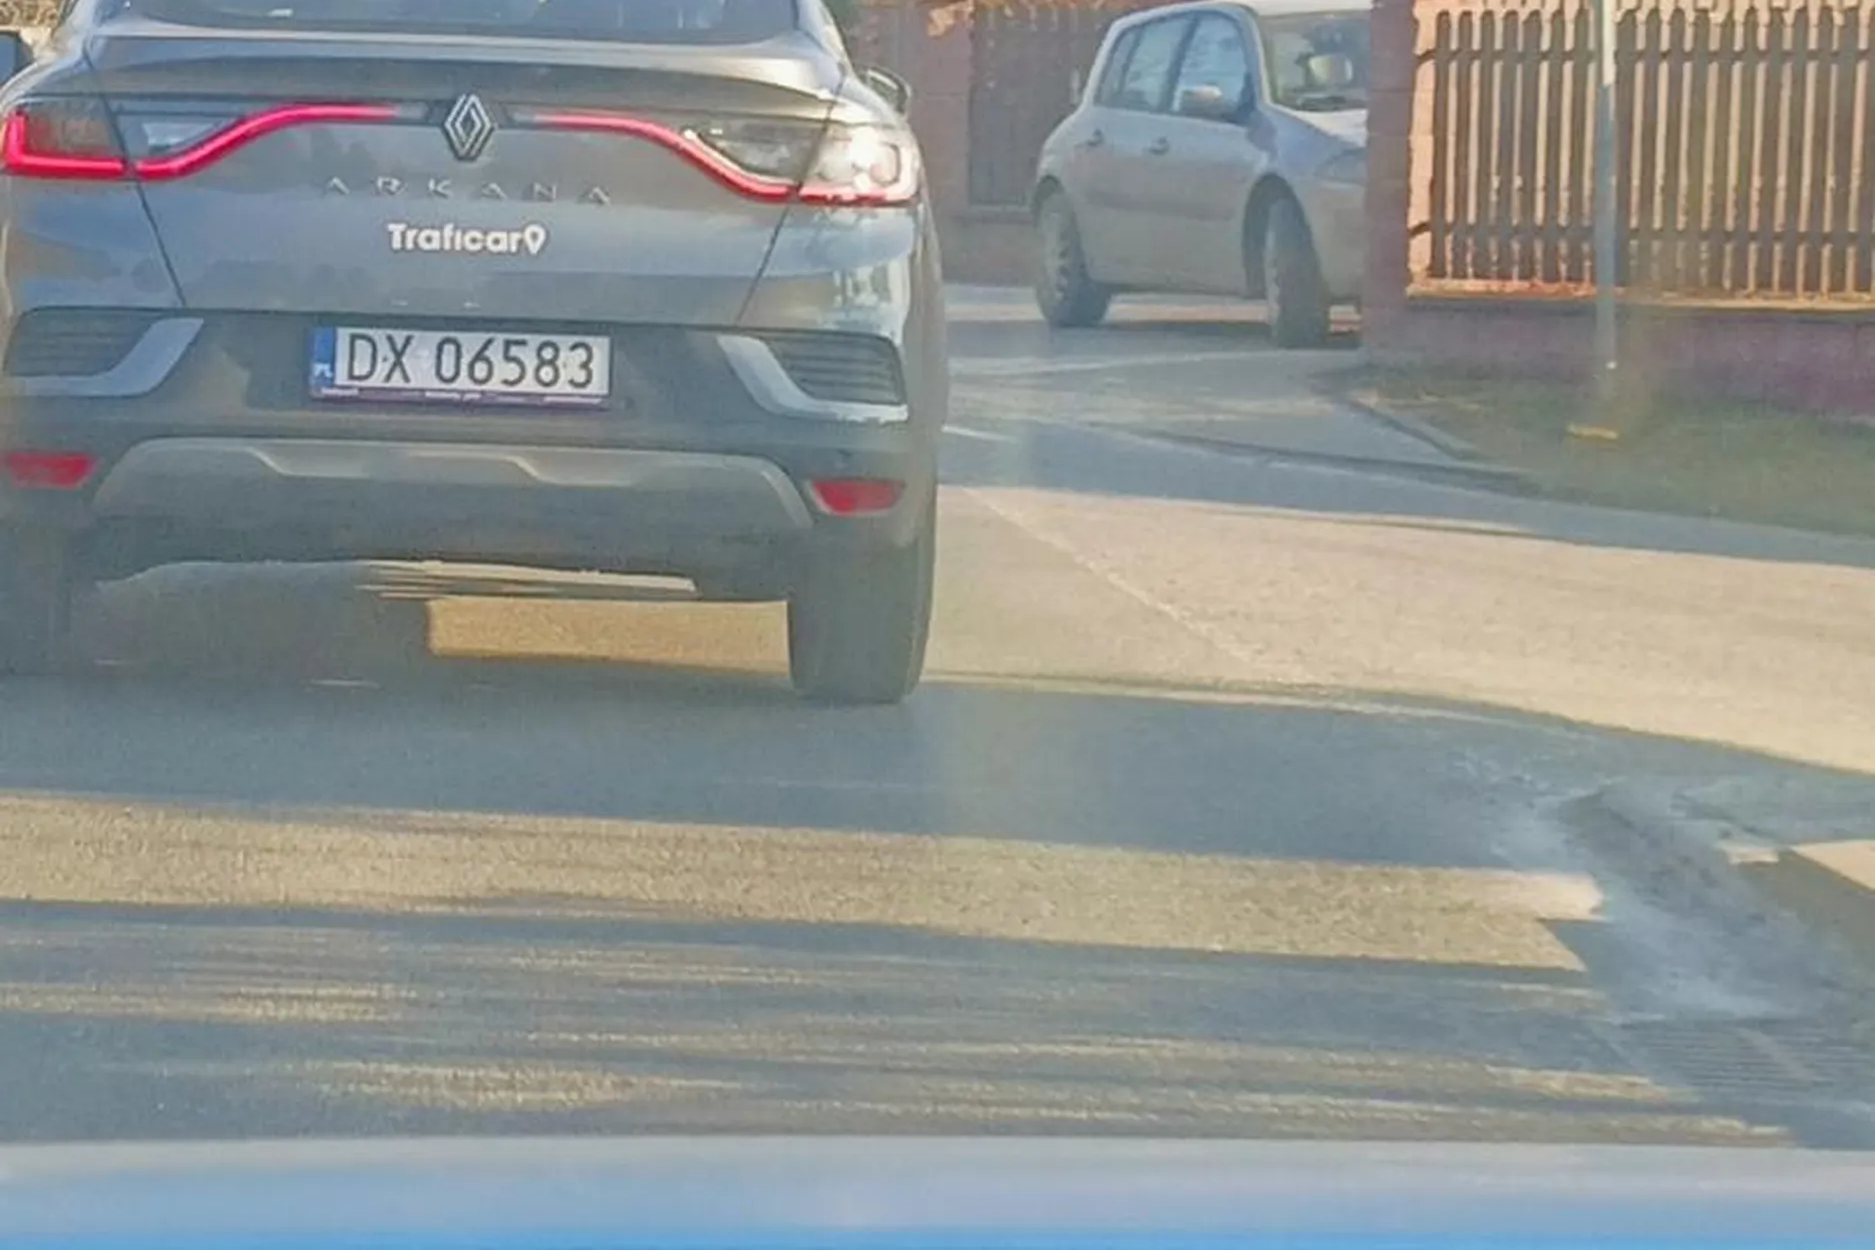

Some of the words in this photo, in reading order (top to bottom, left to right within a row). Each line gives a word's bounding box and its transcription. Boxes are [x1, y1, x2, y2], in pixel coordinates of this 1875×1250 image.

[325, 175, 611, 206] ARKANA
[387, 222, 521, 253] Traficar
[348, 332, 414, 383] DX
[435, 335, 594, 389] 06583
